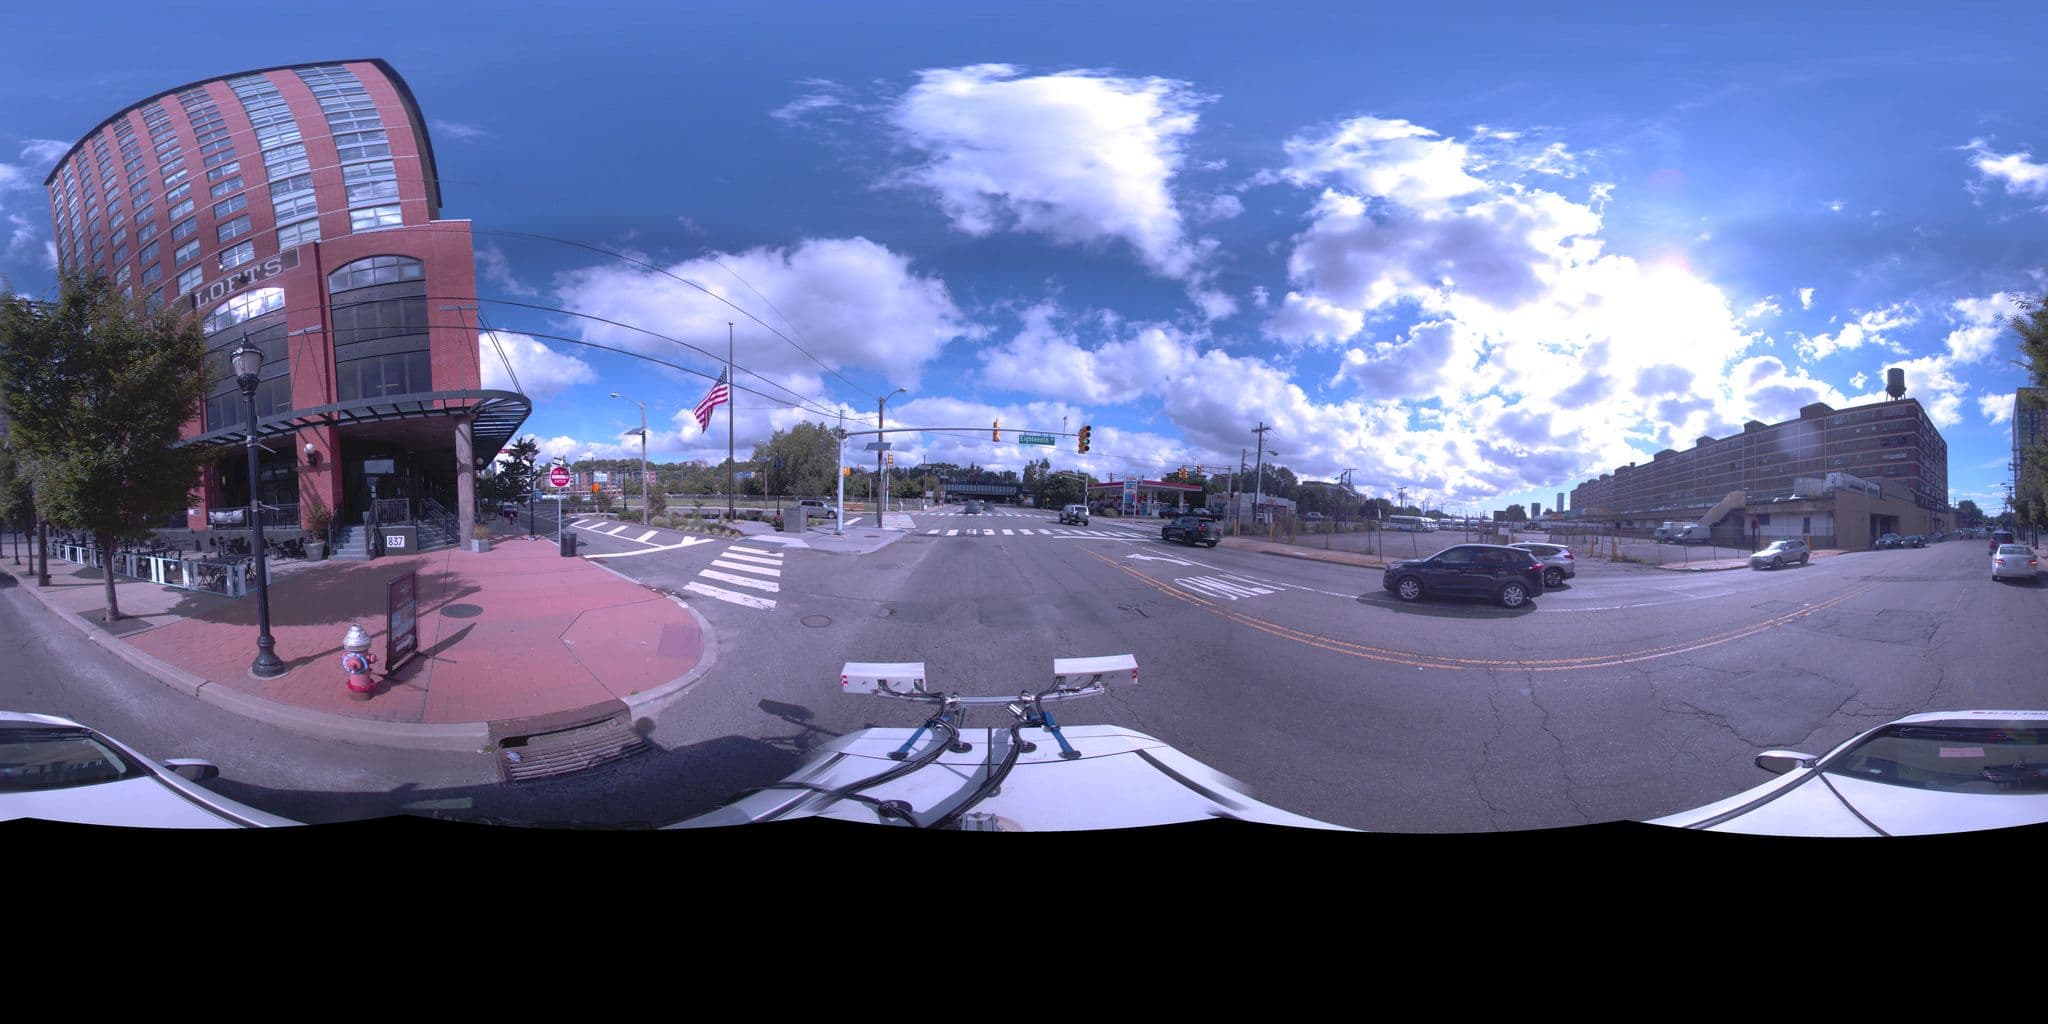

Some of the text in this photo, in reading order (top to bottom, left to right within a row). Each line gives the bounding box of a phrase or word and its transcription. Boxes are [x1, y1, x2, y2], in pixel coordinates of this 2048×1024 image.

[195, 259, 282, 308] LOFTS
[388, 537, 403, 546] 837
[1174, 574, 1286, 601] ONLY
